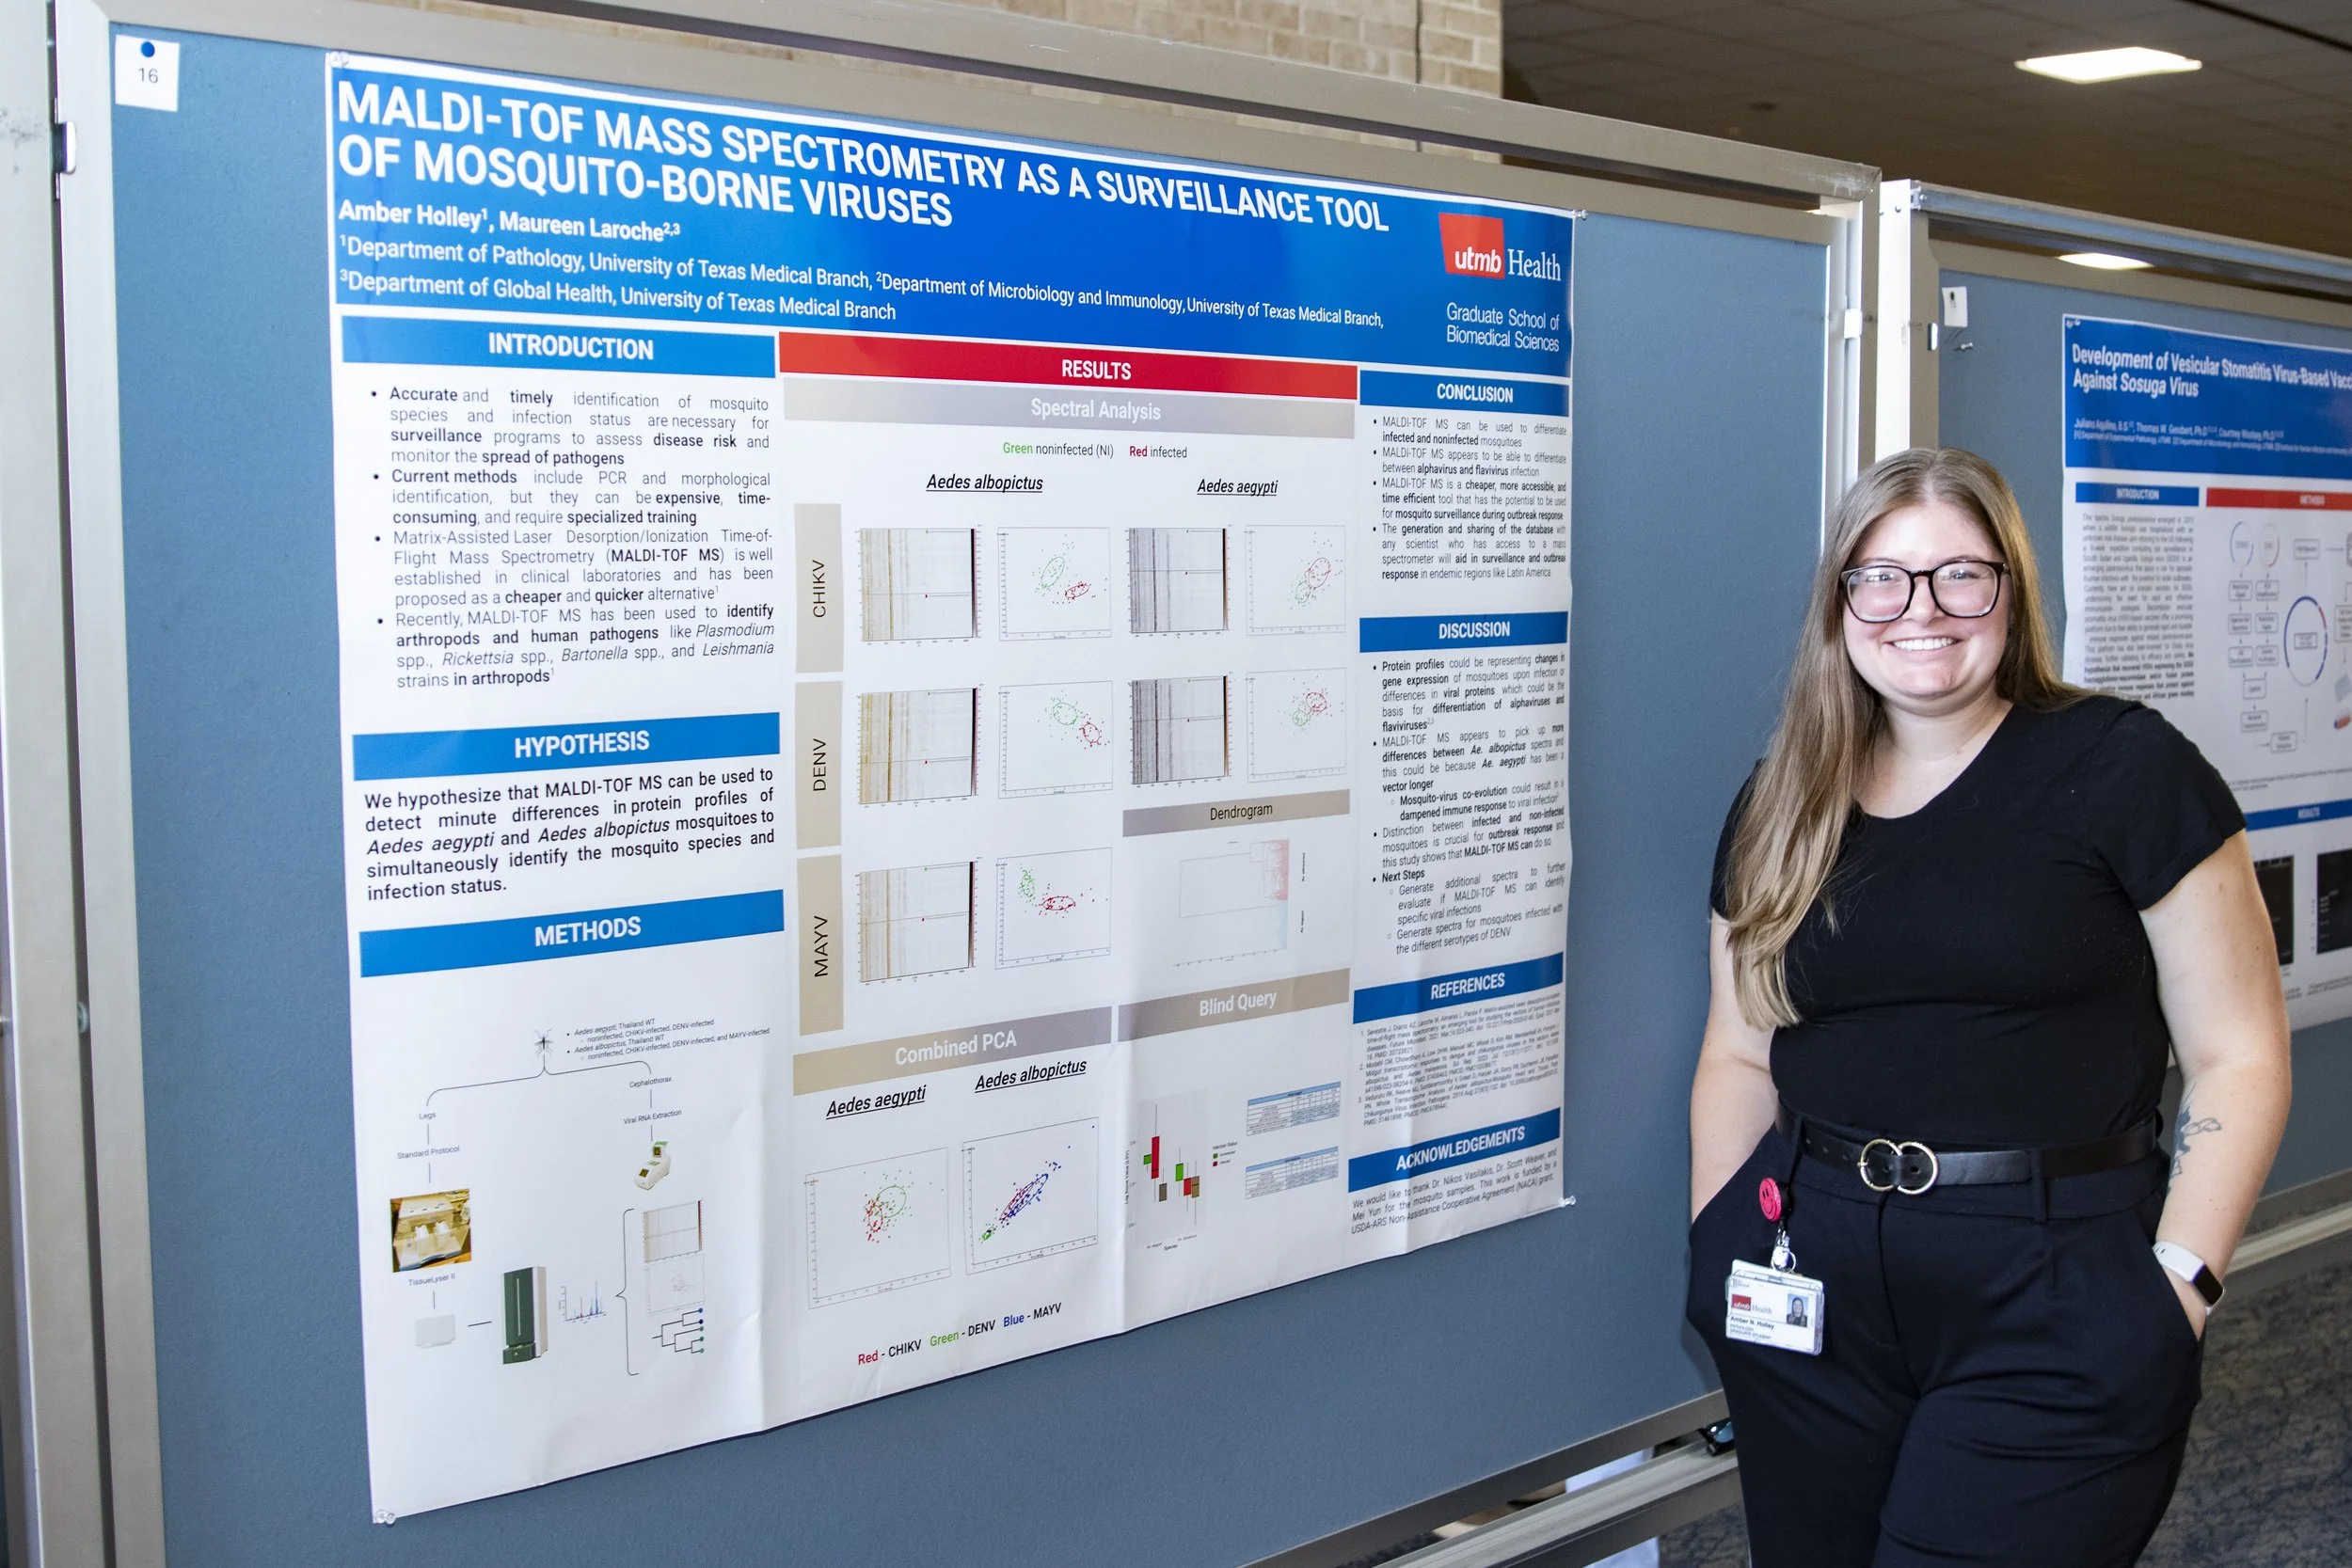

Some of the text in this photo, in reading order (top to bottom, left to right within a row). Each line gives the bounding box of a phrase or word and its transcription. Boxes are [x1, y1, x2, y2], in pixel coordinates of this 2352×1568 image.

[138, 67, 158, 85] 16
[339, 81, 1389, 231] MALDI-TOF MASS SPECTROMETRY AS A SURVEILLANCE TOOL
[339, 135, 952, 227] OF MOSQUITO-BORNE VIRUSES
[339, 199, 411, 223] Amber
[500, 211, 584, 236] Maureen
[1454, 246, 1502, 274] utmb
[1508, 249, 1561, 281] Health
[469, 244, 487, 262] of
[493, 245, 585, 273] Pathology,
[590, 252, 673, 279] University
[676, 258, 694, 276] of
[698, 260, 746, 279] Texas
[751, 263, 812, 284] Medical
[817, 268, 872, 291] Branch,
[970, 280, 984, 295] of
[989, 281, 1074, 307] Microbiology
[1078, 290, 1102, 305] and
[1106, 291, 1184, 314] Immunology,
[1187, 297, 1245, 319] University
[1248, 302, 1260, 316] of
[1263, 303, 1295, 319] Texas
[1299, 307, 1342, 323] Medical
[1344, 310, 1383, 328] Branch,
[469, 277, 488, 296] of
[494, 278, 550, 299] Global
[556, 282, 616, 306] Health,
[621, 287, 703, 312] University
[707, 292, 723, 309] of
[728, 293, 775, 313] Texas
[780, 296, 839, 316] Medical
[845, 301, 896, 319] Branch
[1447, 302, 1559, 330] Graduate School of
[489, 332, 653, 359] INTRODUCTION
[1447, 325, 1559, 352] Biomedical Sciences
[1062, 359, 1131, 380] RESULTS
[2073, 343, 2153, 373] Development
[2156, 352, 2169, 371] of
[2171, 354, 2220, 378] Vesicular
[2221, 358, 2273, 381] Stomatitis
[2273, 364, 2329, 387] Virus-Based
[1438, 384, 1513, 403] CONCLUSION
[2074, 368, 2199, 399] Against Sosuga Virus
[389, 387, 768, 413] Accurate and timely identification of mosquito
[1032, 398, 1161, 423] Spectral Analysis
[391, 409, 769, 432] species and infection status are necessary for
[1004, 442, 1186, 458] Green noninfected (NI) Red infected
[1383, 433, 1521, 447] infected and noninfected mosquitoes
[926, 474, 1042, 493] Aedes albopictus
[1198, 479, 1278, 497] Aedes aegypti
[813, 561, 825, 617] CHIKV
[1439, 622, 1510, 639] DISCUSSION
[516, 730, 649, 758] HYPOTHESIS
[814, 739, 825, 791] DENV
[365, 768, 772, 810] We hypothesize that MALDI-TOF MS can be used to
[1383, 780, 1434, 792] vector longer
[1211, 805, 1272, 820] Dendrogram
[1382, 870, 1424, 882] Next Steps
[535, 916, 641, 946] METHODS
[815, 916, 828, 976] MAYV
[1431, 973, 1504, 999] REFERENCES
[1200, 992, 1277, 1016] Blind Query
[896, 1030, 1017, 1065] Combined PCA
[629, 1077, 671, 1087] Cephalothorax
[975, 1061, 1087, 1093] Aedes albopictus
[653, 1111, 681, 1119] Extraction
[826, 1085, 926, 1119] Aedes aegypti
[398, 1146, 459, 1159] Standard Protocol
[1396, 1126, 1525, 1171] ACKNOWLEDGEMENTS
[859, 1350, 878, 1365] Red
[889, 1339, 921, 1356] CHIKV
[930, 1332, 959, 1346] Green
[968, 1320, 995, 1337] DENV
[1004, 1315, 1025, 1327] Blue
[1034, 1303, 1061, 1319] MAYV
